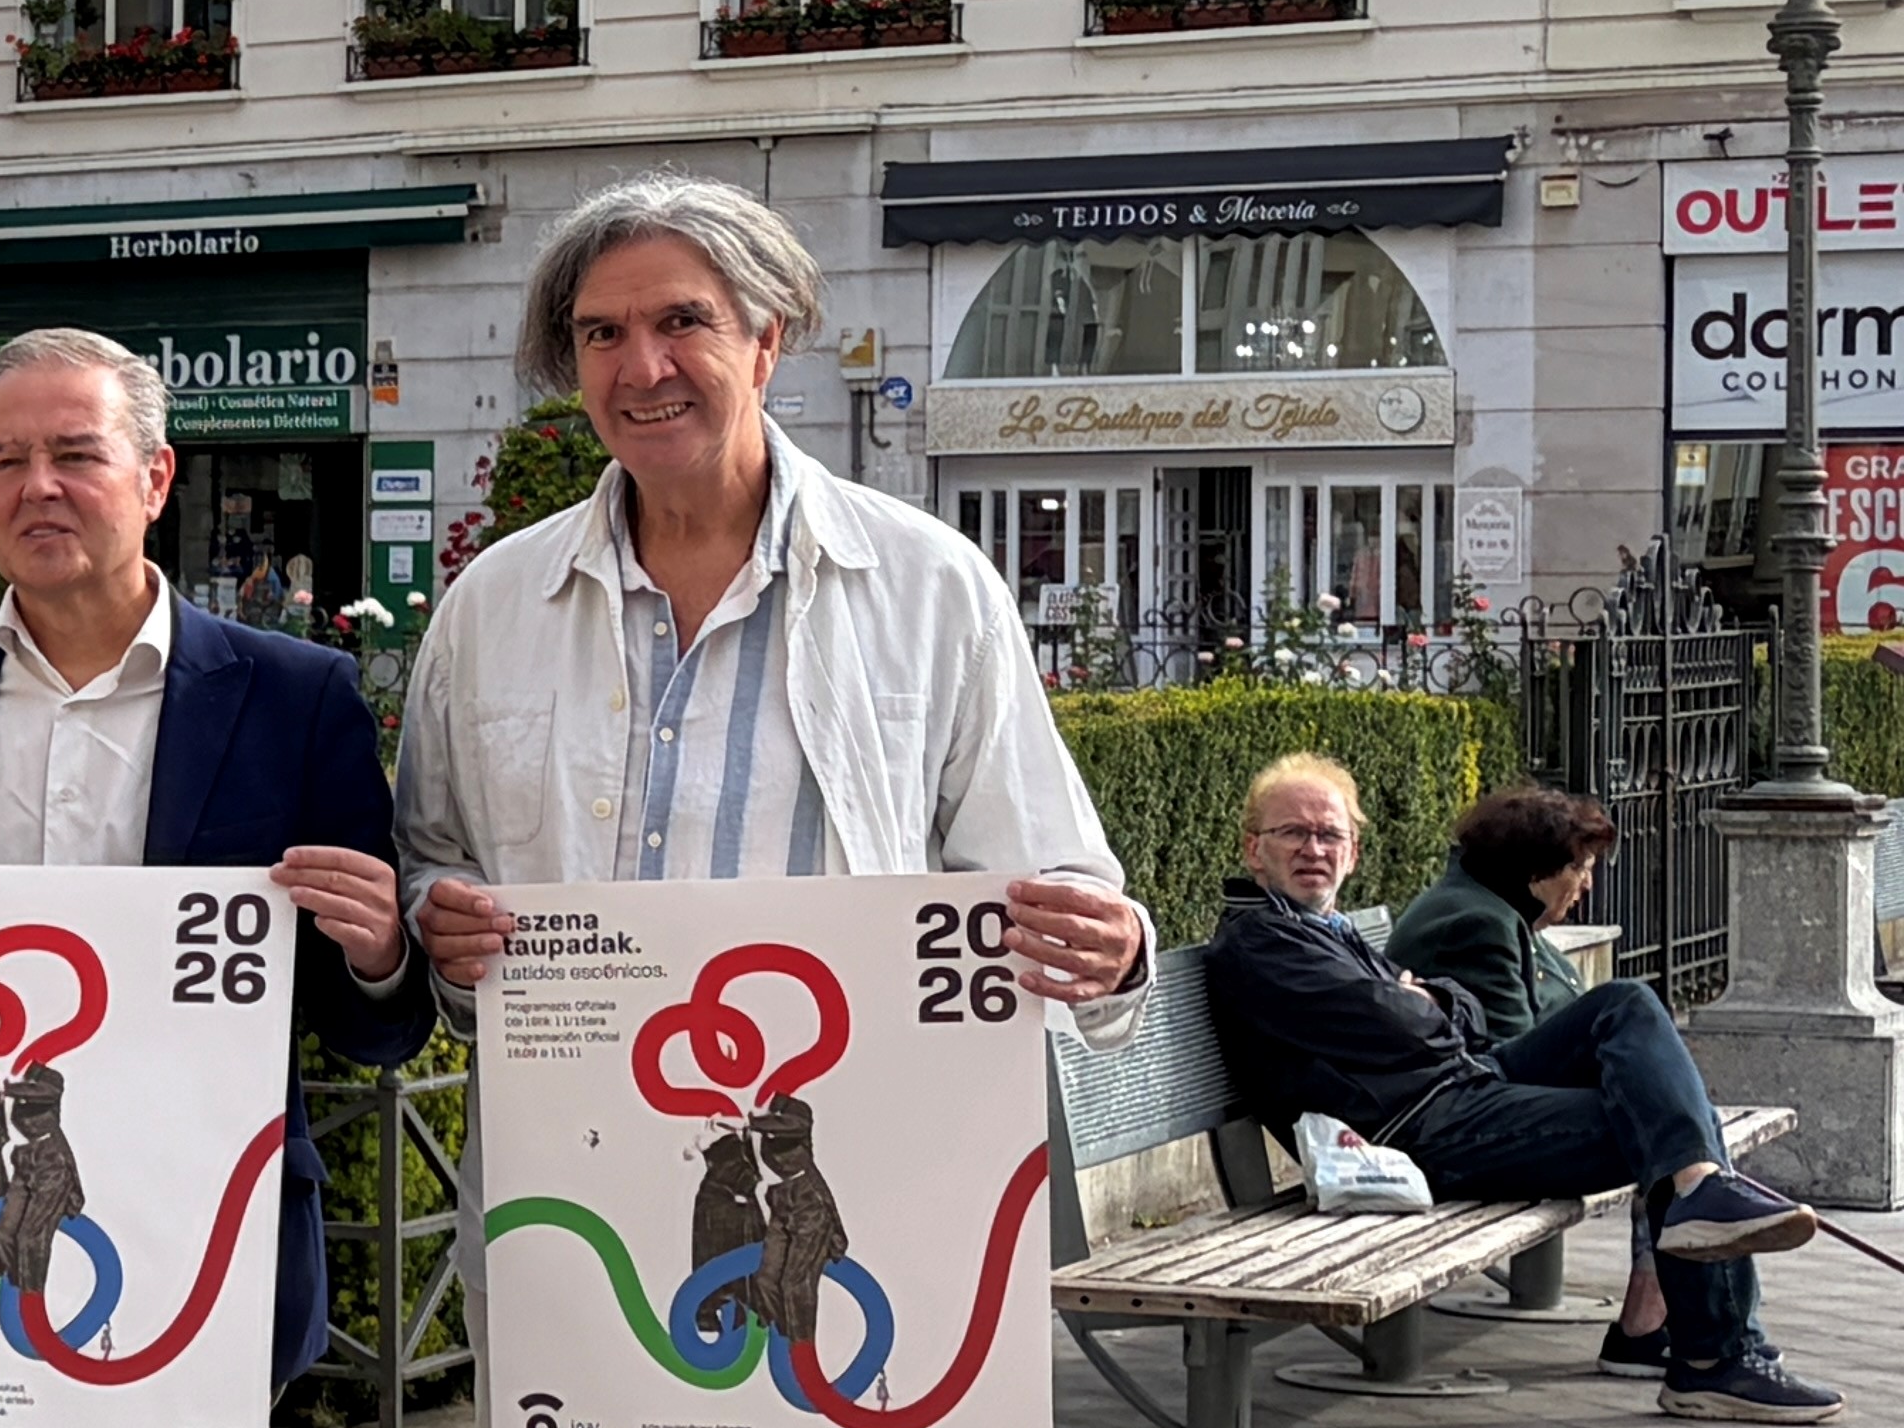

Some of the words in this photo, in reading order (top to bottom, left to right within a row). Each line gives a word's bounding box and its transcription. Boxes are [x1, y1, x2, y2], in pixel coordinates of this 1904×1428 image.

[1052, 203, 1177, 228] TEJIDOS
[1189, 207, 1207, 224] &
[1676, 183, 1904, 234] OULE
[109, 228, 260, 261] Herbolario
[1722, 369, 1896, 392] COLHON
[218, 393, 284, 408] Cosmética
[174, 416, 270, 432] Complementos
[273, 413, 339, 429] Dietéticos
[998, 396, 1047, 443] La
[1054, 397, 1184, 440] Boutique
[1193, 399, 1232, 428] del
[1242, 394, 1341, 440] Tejido
[176, 892, 270, 946] 20
[916, 901, 1016, 959] 20
[503, 931, 642, 961] taupadak.
[173, 951, 266, 1004] 26
[502, 965, 565, 980] Latidos
[919, 965, 1017, 1023] 26
